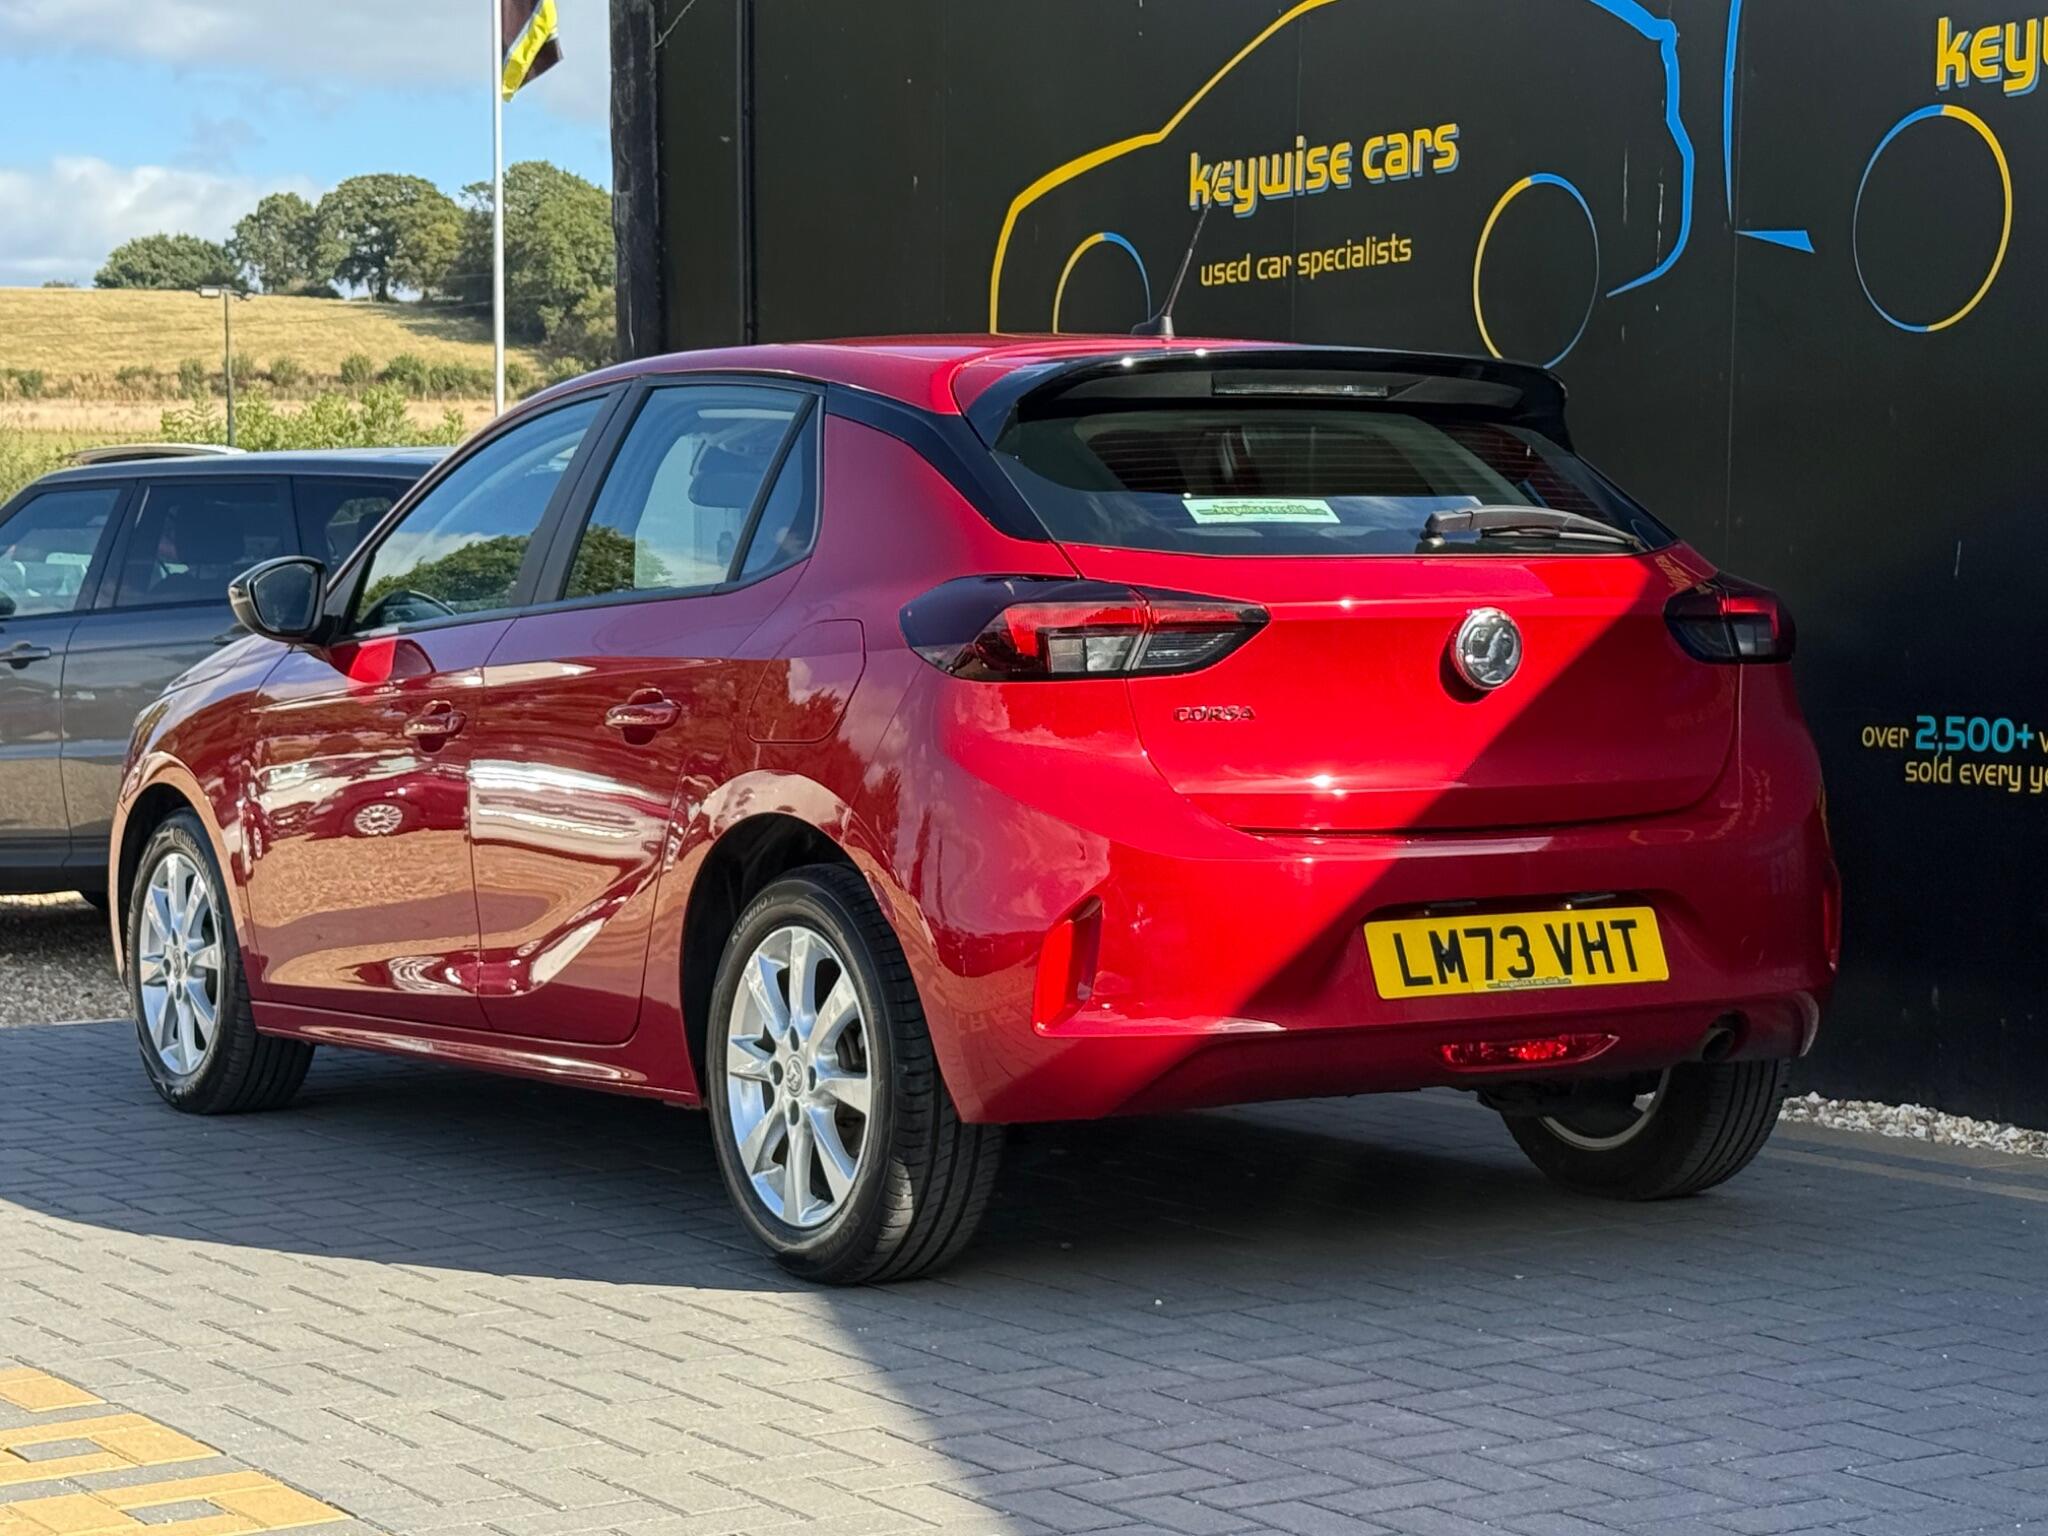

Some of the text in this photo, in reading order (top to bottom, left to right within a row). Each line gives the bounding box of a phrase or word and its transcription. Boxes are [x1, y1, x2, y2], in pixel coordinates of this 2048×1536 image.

[1936, 16, 2048, 97] key
[1189, 123, 1459, 218] keywise cars
[1200, 233, 1412, 286] used car specialists
[1173, 705, 1256, 722] CORSA
[1862, 725, 1909, 748] over
[1915, 715, 2034, 757] 2,500+
[1905, 755, 1952, 783] sold
[1959, 763, 2022, 793] every
[1393, 919, 1638, 987] LM73 VHT
